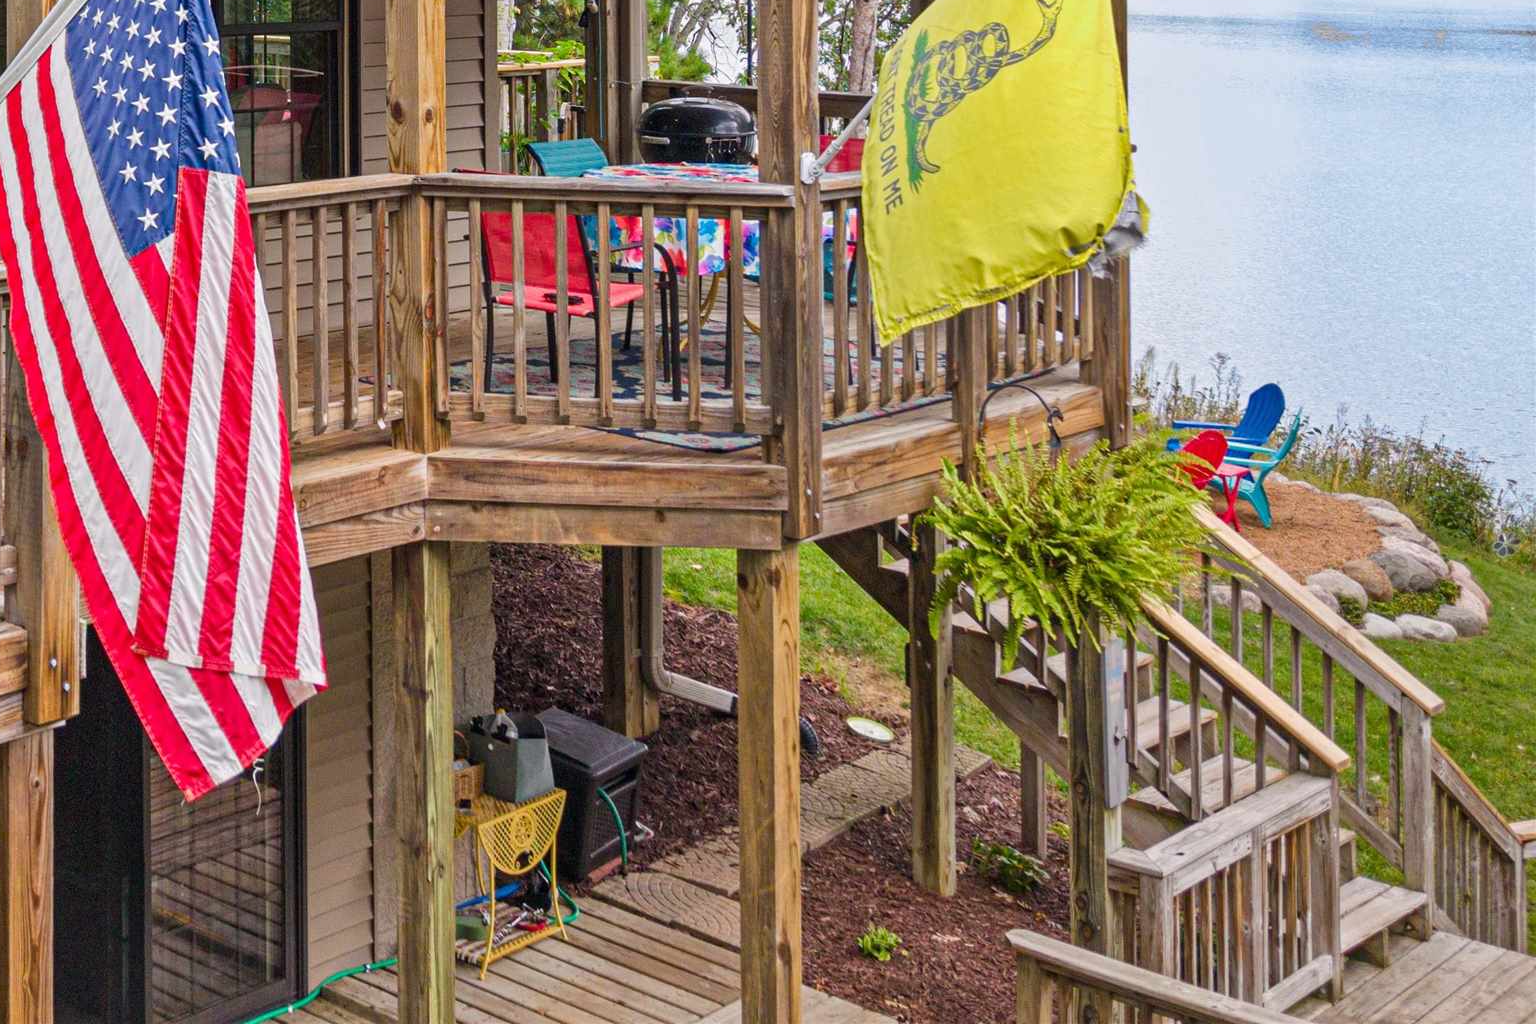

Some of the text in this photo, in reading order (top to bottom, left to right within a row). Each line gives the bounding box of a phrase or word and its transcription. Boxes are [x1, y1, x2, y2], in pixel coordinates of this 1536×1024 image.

[879, 81, 897, 142] TREAD
[880, 144, 899, 177] ON
[882, 177, 904, 216] ME
